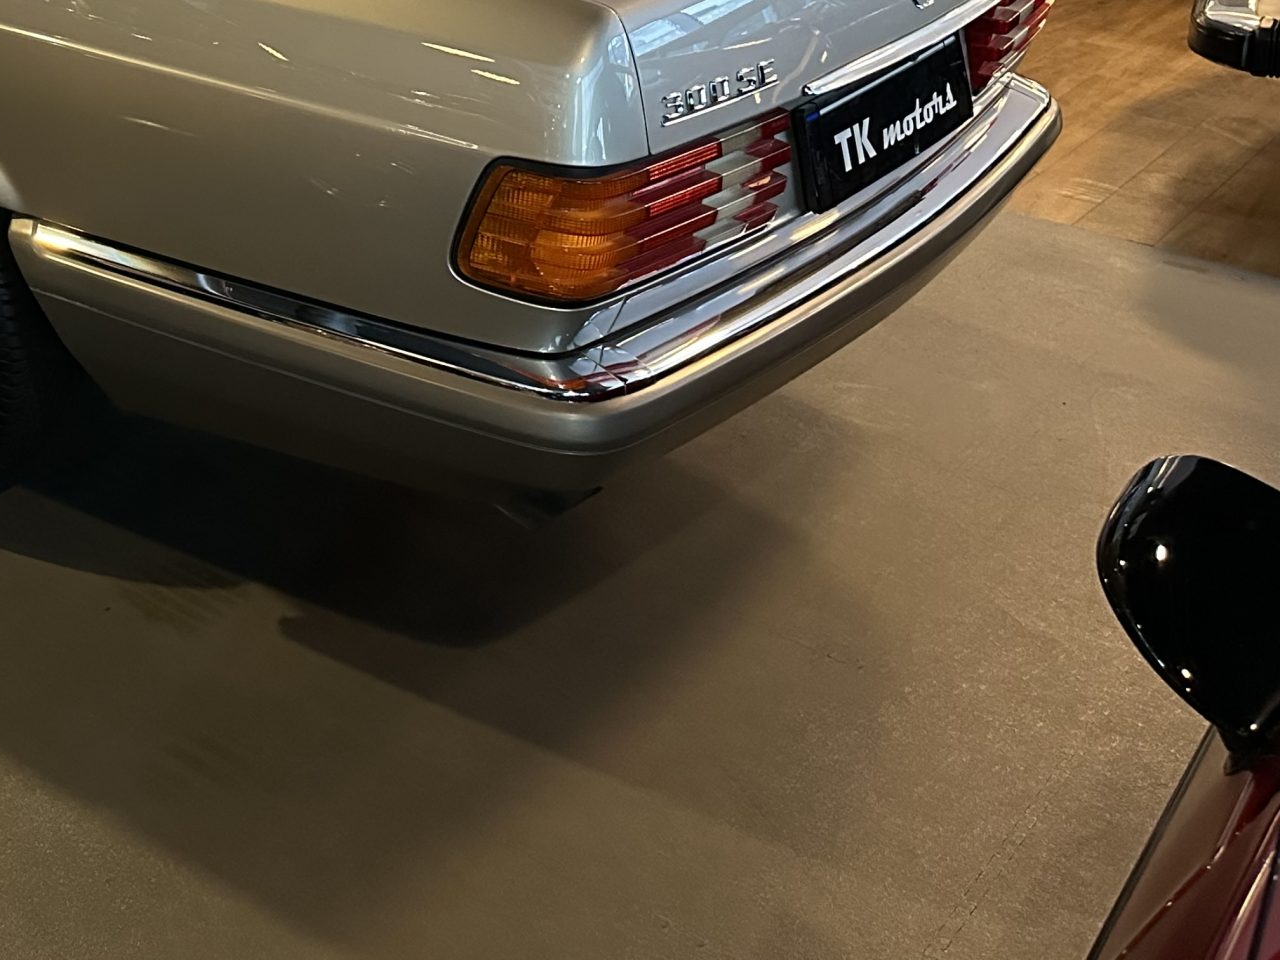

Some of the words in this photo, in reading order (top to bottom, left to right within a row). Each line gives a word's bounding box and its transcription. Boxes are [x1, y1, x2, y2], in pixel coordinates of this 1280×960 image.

[661, 76, 729, 119] 300
[736, 59, 777, 95] SE
[834, 117, 877, 172] TK
[883, 82, 957, 150] motors
